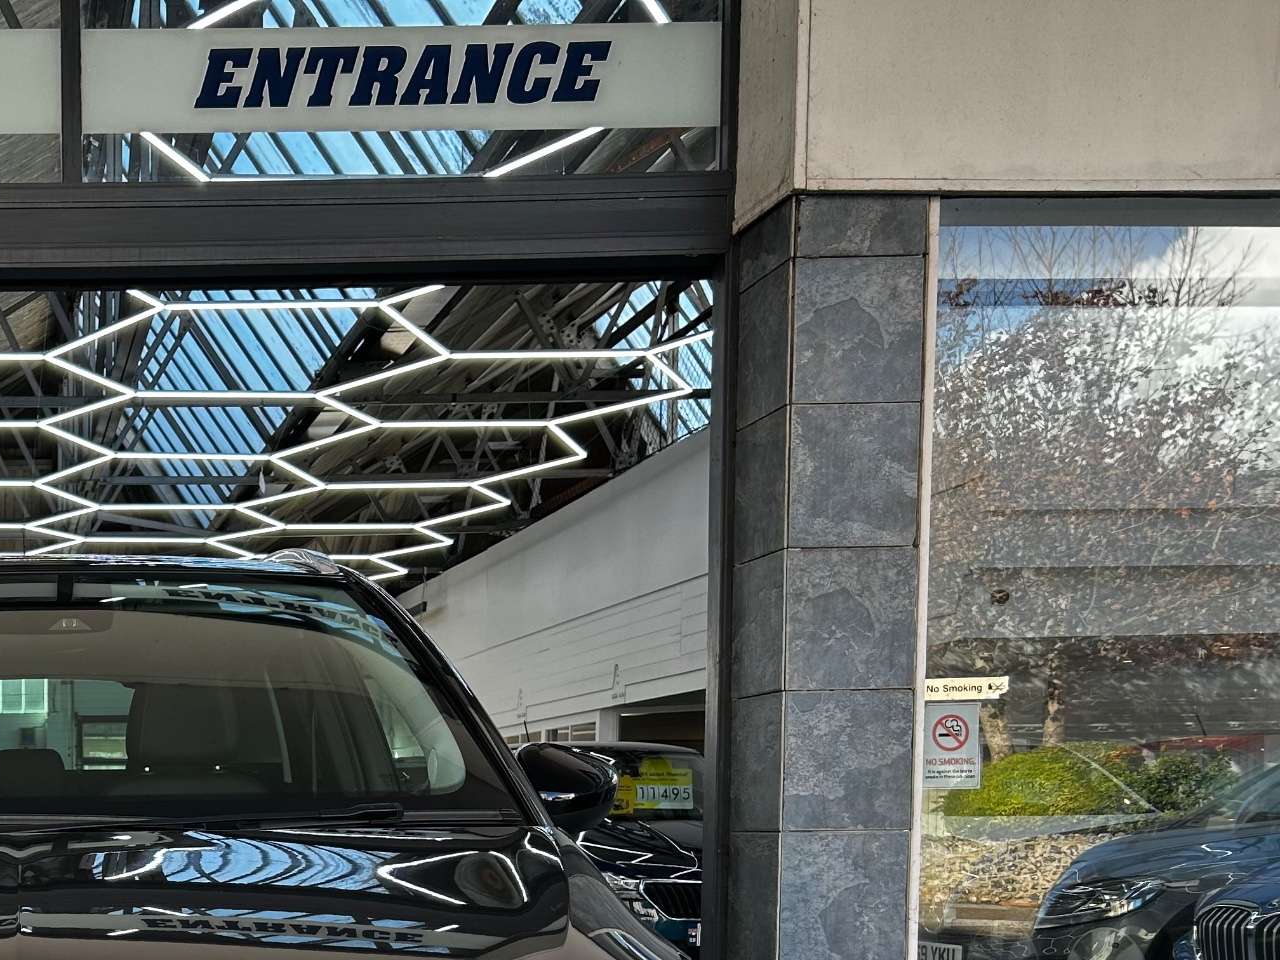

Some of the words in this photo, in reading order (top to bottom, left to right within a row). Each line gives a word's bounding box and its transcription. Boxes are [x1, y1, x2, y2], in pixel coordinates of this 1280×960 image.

[193, 40, 613, 109] ENTRANCE
[926, 685, 940, 694] No
[942, 683, 983, 694] Smoking
[925, 758, 937, 766] NO
[639, 786, 690, 801] 11495
